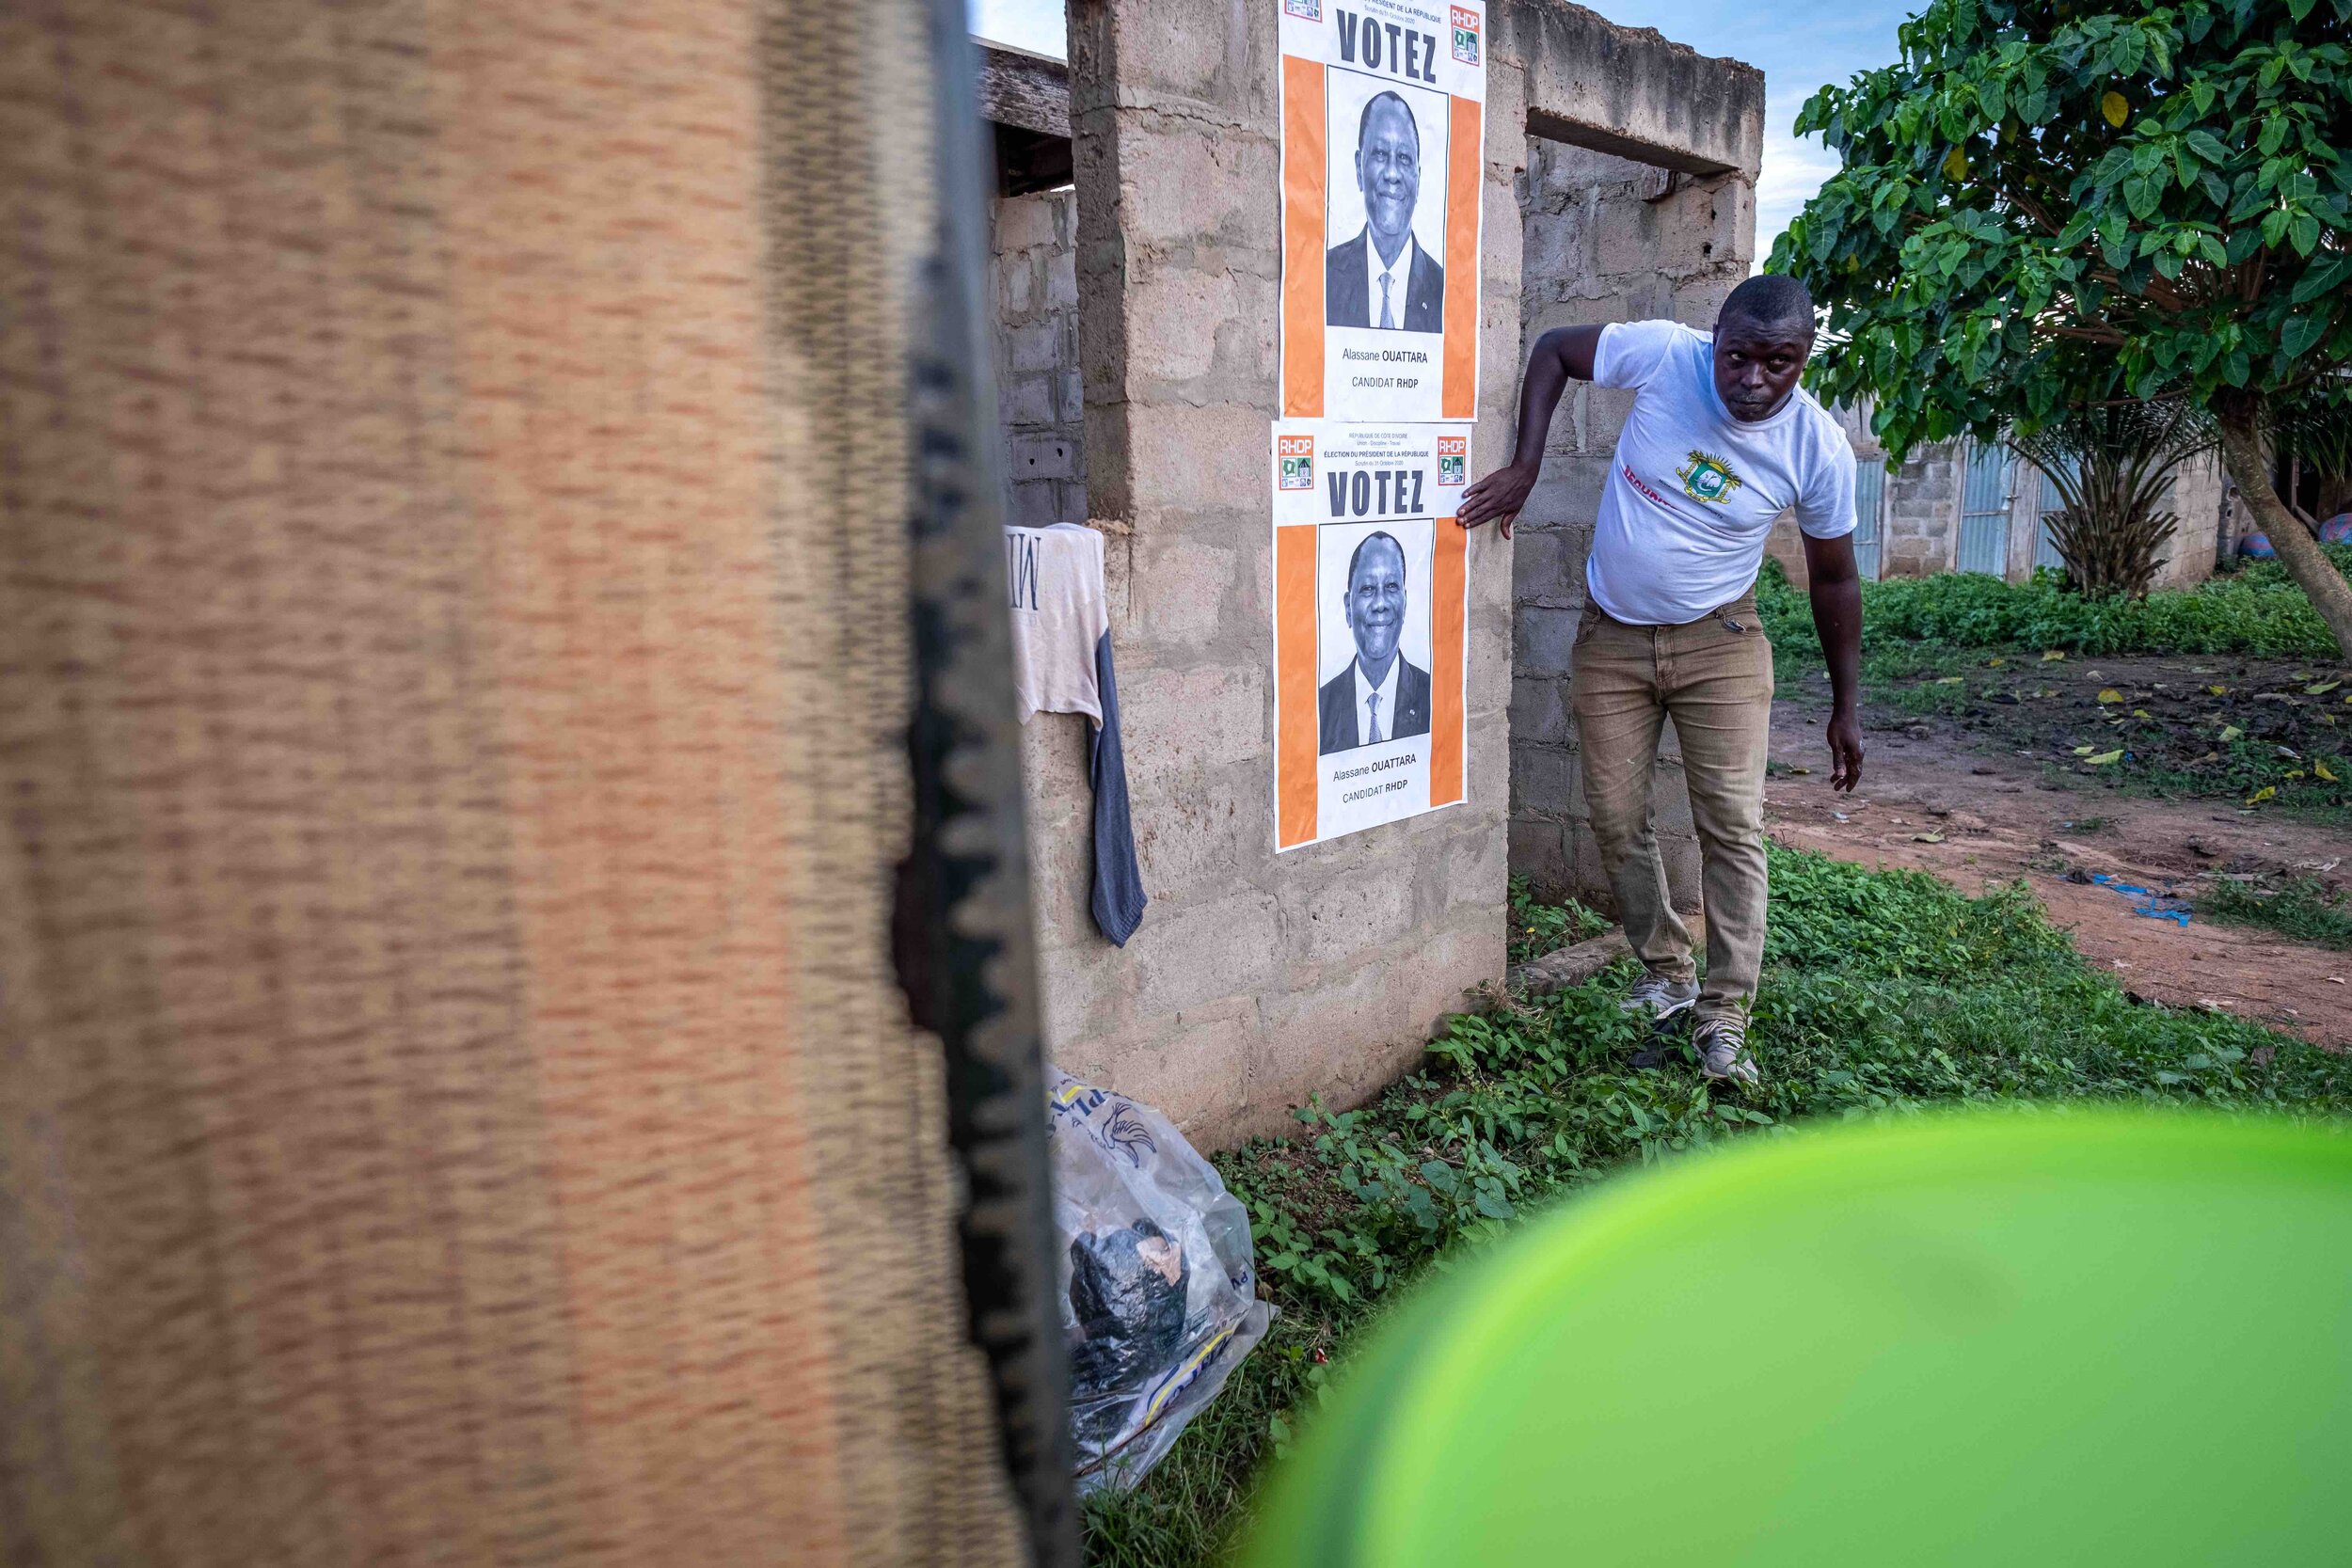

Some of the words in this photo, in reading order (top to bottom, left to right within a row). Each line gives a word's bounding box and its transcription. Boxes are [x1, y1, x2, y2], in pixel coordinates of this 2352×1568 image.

[1452, 9, 1478, 29] RHDP
[1336, 8, 1436, 84] VOTEZ
[1343, 348, 1380, 361] Alassane
[1382, 350, 1428, 364] OUATTARA
[1352, 376, 1394, 388] CANDIDAT
[1396, 378, 1419, 389] RHDP
[1279, 438, 1312, 454] RHDP
[1324, 450, 1350, 458] ÉLECTION
[1359, 450, 1386, 458] PRÉSIDENT
[1401, 450, 1429, 458] RÉPUBLIQUE
[1438, 439, 1465, 453] RHDP
[1327, 470, 1423, 517] VOTEZ
[1333, 766, 1370, 783] Alassane
[1372, 753, 1417, 772] OUATTARA
[1343, 784, 1384, 803] CANDIDAT
[1385, 779, 1408, 792] RHDP
